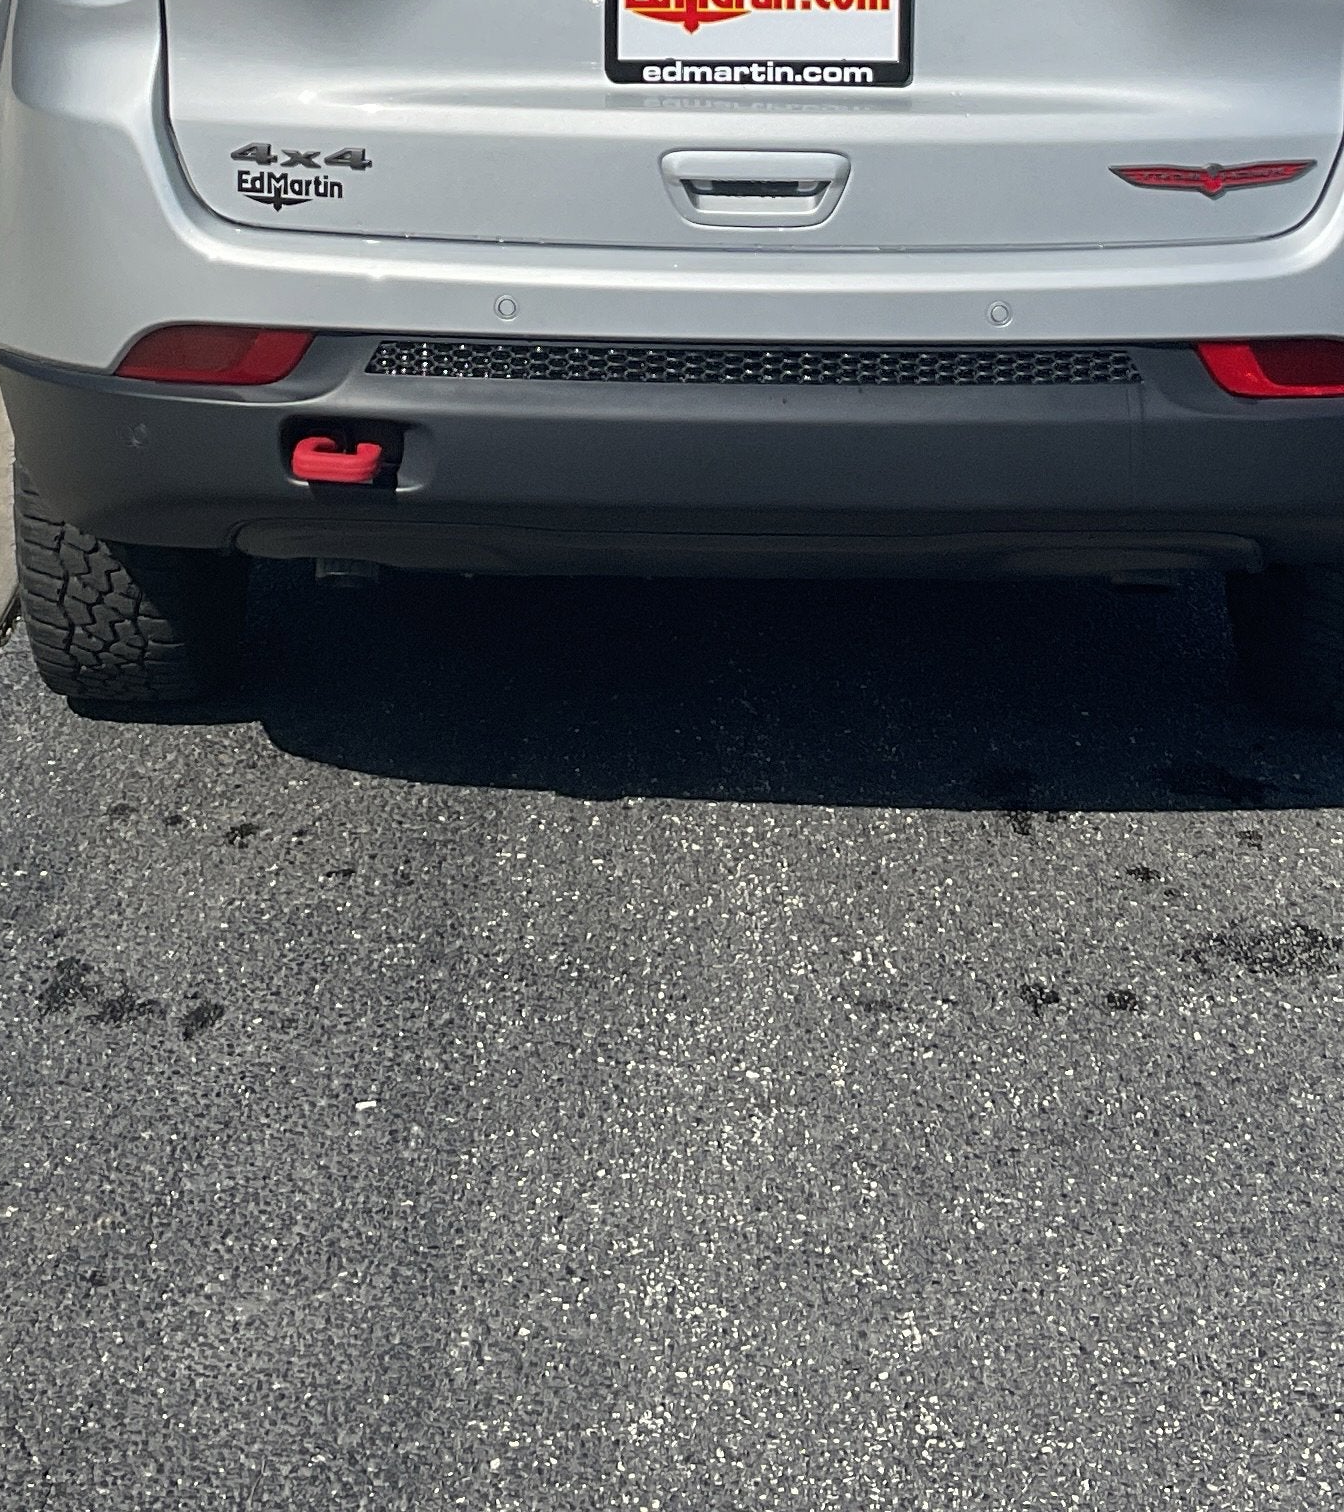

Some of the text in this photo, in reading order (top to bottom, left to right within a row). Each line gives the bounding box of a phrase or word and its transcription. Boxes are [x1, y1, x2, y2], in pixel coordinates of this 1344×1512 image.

[642, 61, 874, 85] edmartin.com
[230, 141, 373, 172] 4x4
[237, 169, 344, 204] EdMartin
